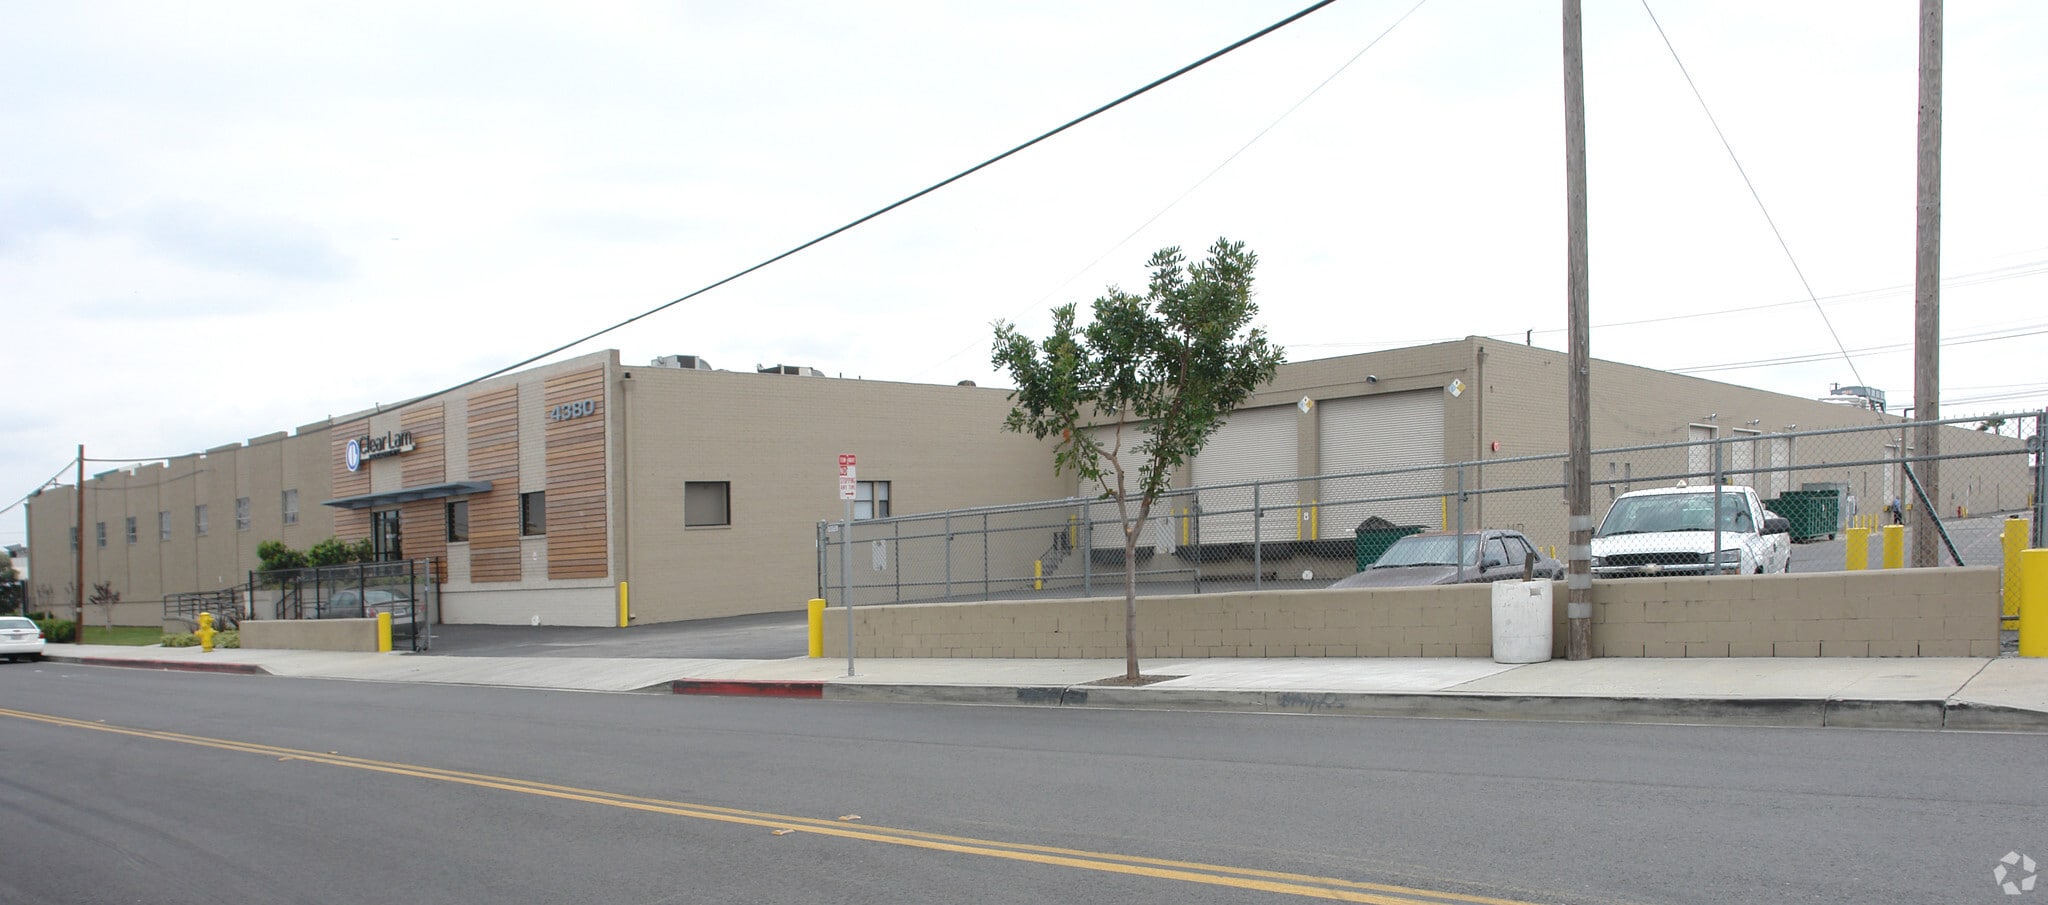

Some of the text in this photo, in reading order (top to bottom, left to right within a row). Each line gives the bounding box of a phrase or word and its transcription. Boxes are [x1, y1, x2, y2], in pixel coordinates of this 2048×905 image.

[551, 399, 595, 421] 4380
[359, 434, 387, 454] Clear
[387, 430, 413, 449] Lam
